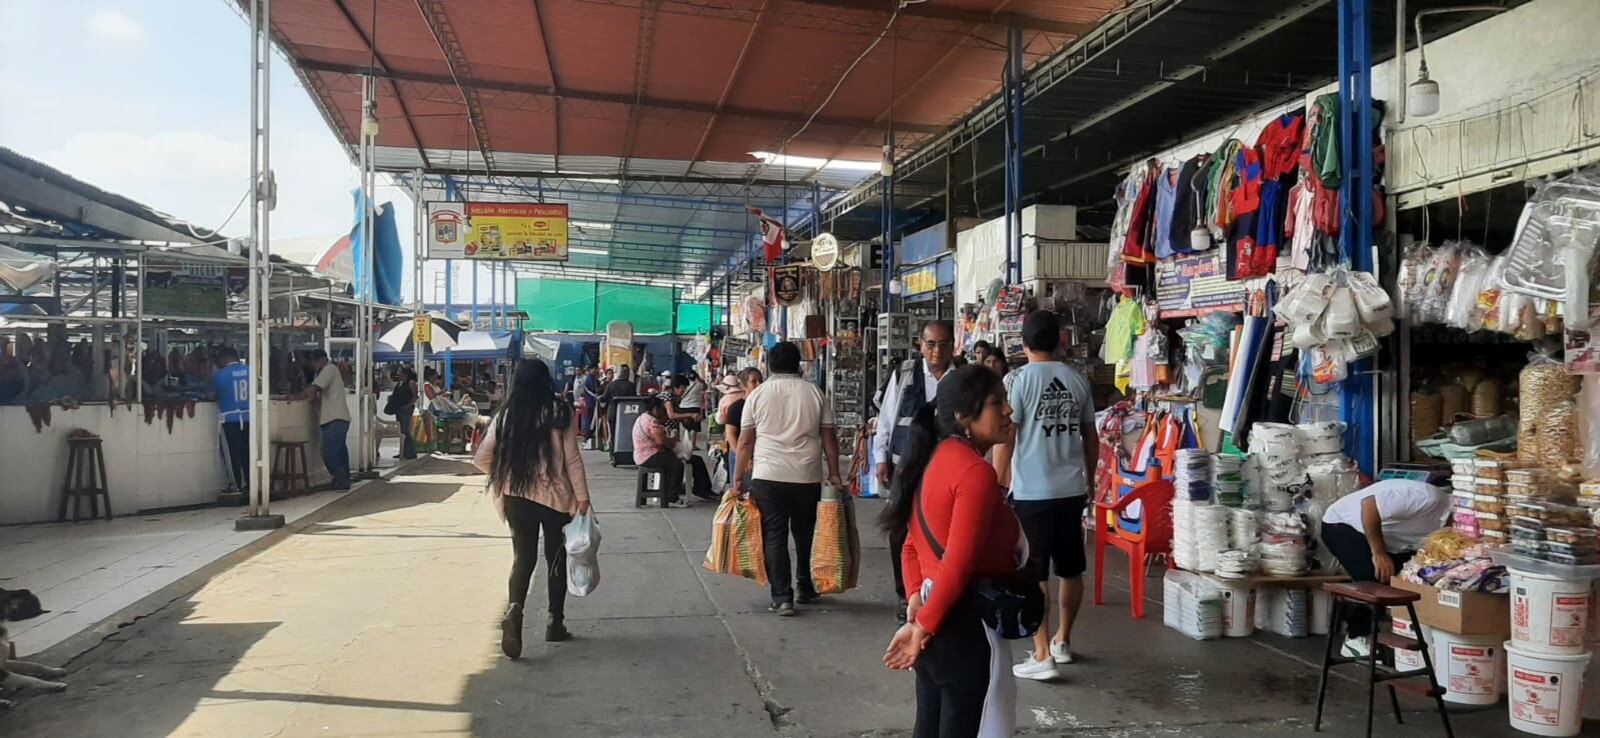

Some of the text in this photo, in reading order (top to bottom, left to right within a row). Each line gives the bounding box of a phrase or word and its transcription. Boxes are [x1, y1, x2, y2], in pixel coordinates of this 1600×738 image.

[233, 379, 248, 402] 18
[1042, 391, 1073, 400] adidas
[1042, 423, 1079, 437] YPF
